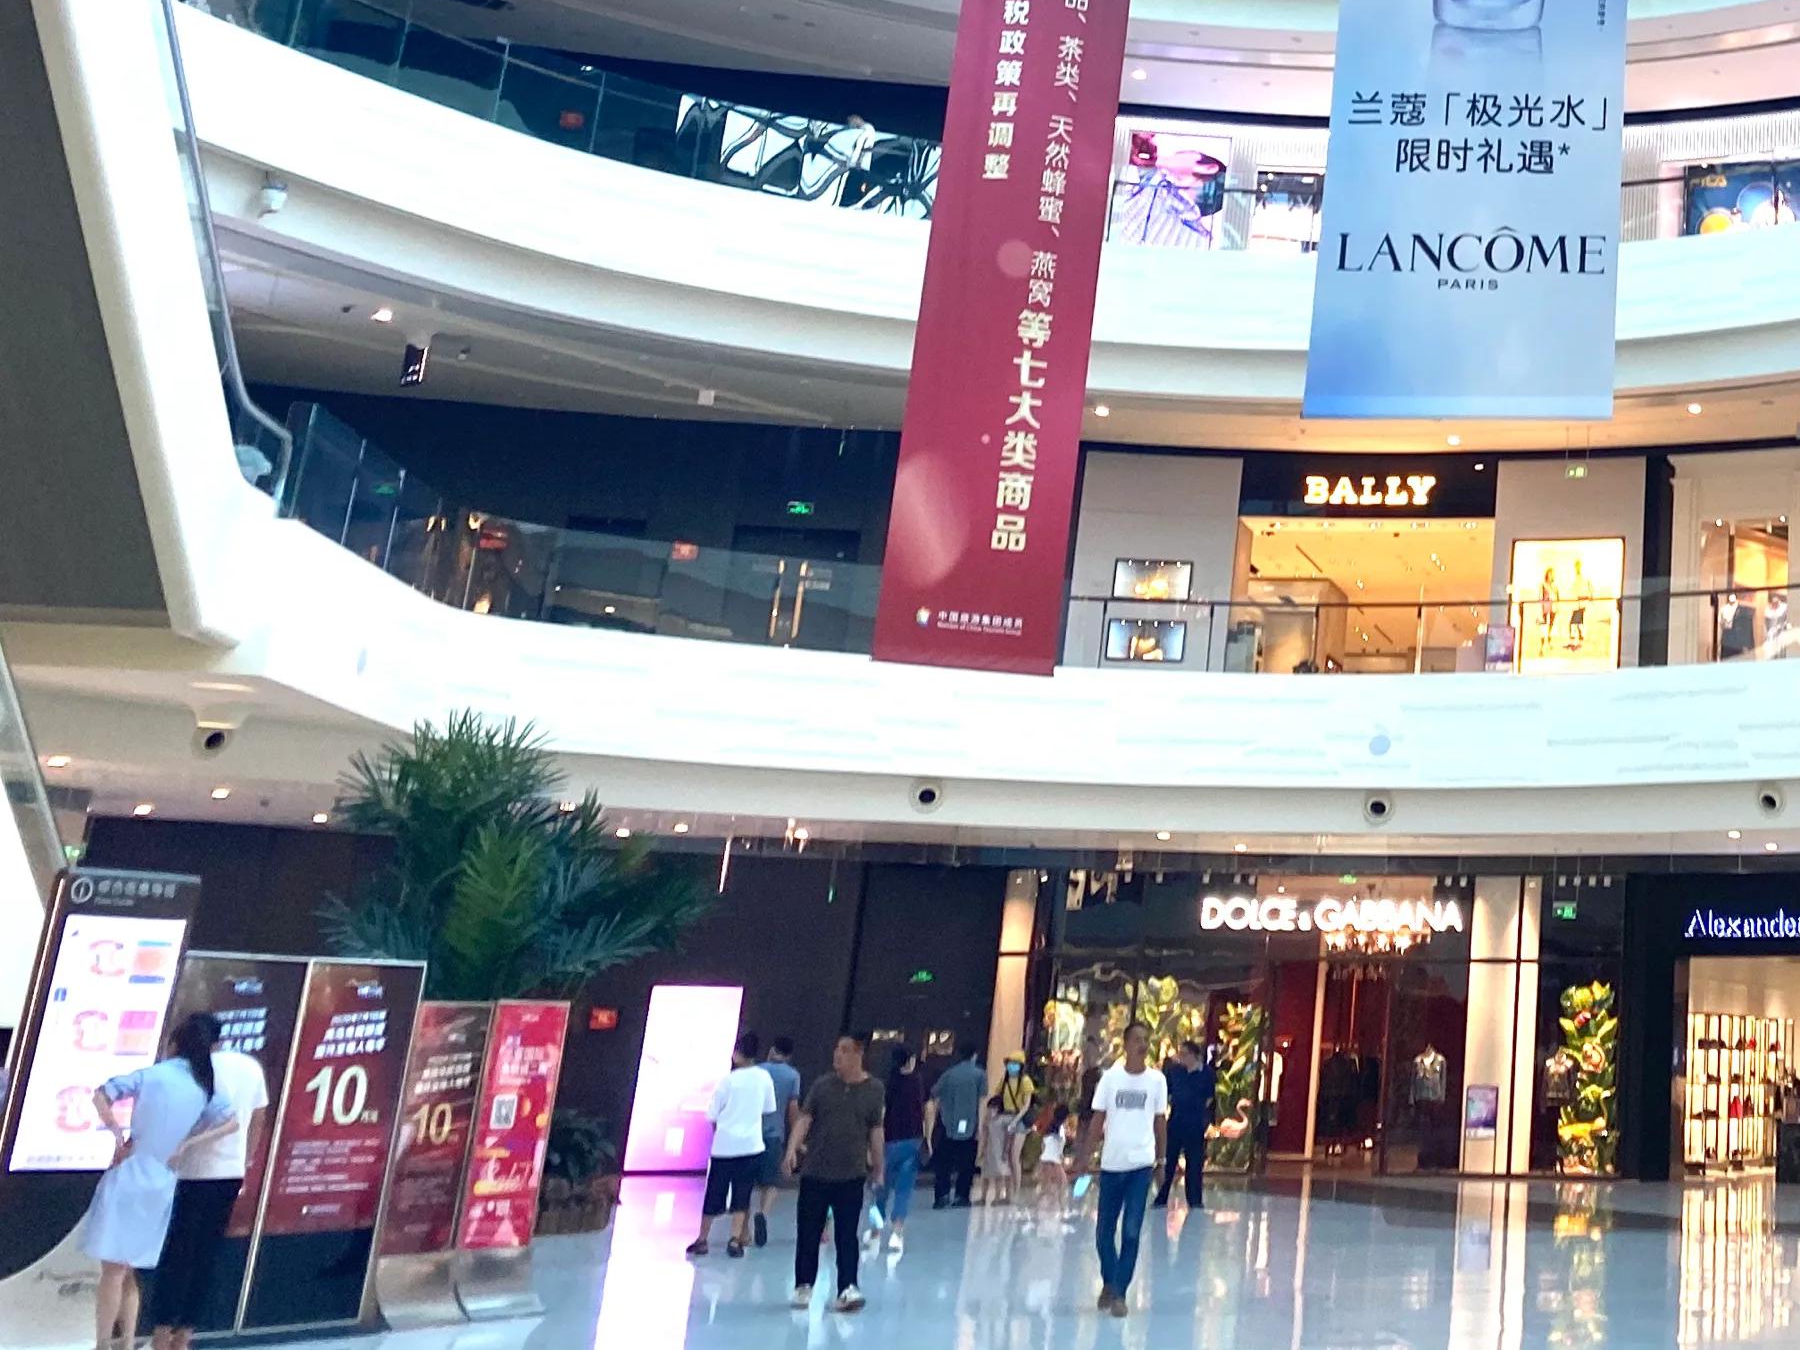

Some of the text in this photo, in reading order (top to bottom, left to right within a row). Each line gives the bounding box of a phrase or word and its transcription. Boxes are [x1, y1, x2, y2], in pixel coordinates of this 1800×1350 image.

[1347, 90, 1608, 131] 兰蔻「极光水」
[1336, 226, 1606, 275] LANCÔME
[1438, 278, 1498, 291] PARIS
[1304, 475, 1436, 505] BALLY
[1201, 897, 1297, 930] DOLCE
[1313, 898, 1463, 932] GABBANA
[305, 1064, 368, 1126] 10
[411, 1102, 452, 1145] 10
